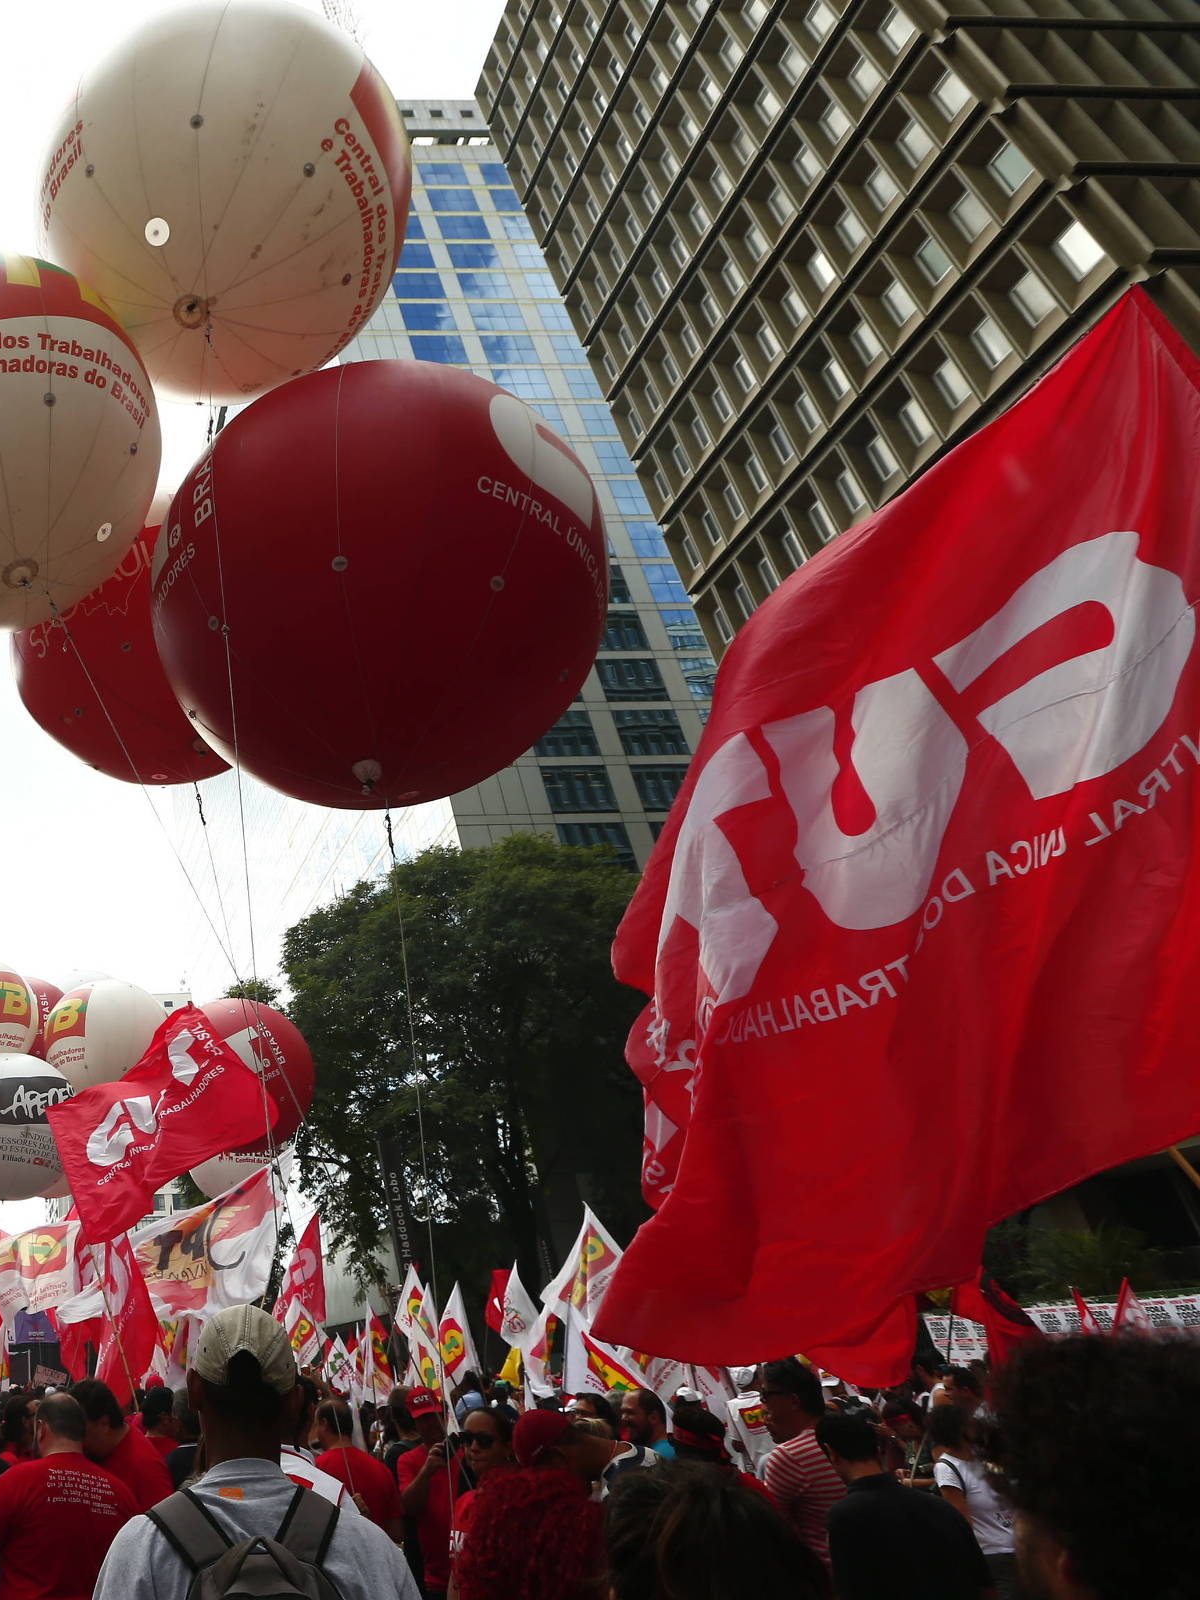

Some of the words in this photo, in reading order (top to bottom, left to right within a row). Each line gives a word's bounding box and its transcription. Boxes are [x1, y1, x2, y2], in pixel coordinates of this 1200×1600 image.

[49, 138, 83, 202] Brasil
[334, 118, 384, 197] Central
[376, 199, 388, 244] dos
[320, 138, 334, 152] e
[334, 149, 375, 299] Trabalhadoras
[36, 332, 152, 419] Trabalhadores
[83, 368, 107, 389] do
[109, 380, 146, 430] Brasil
[477, 475, 562, 536] CENTRAL
[566, 526, 601, 580] ÚNICA
[6, 1040, 22, 1049] Brasil
[160, 1064, 225, 1118] RABALHADORES
[2, 1154, 26, 1163] Filiado
[9, 1145, 39, 1155] ESTADO
[40, 1151, 51, 1159] DE
[39, 1143, 50, 1151] DO
[389, 1171, 402, 1201] Lobo
[393, 1204, 412, 1258] Haddock
[413, 1394, 432, 1404] CUT
